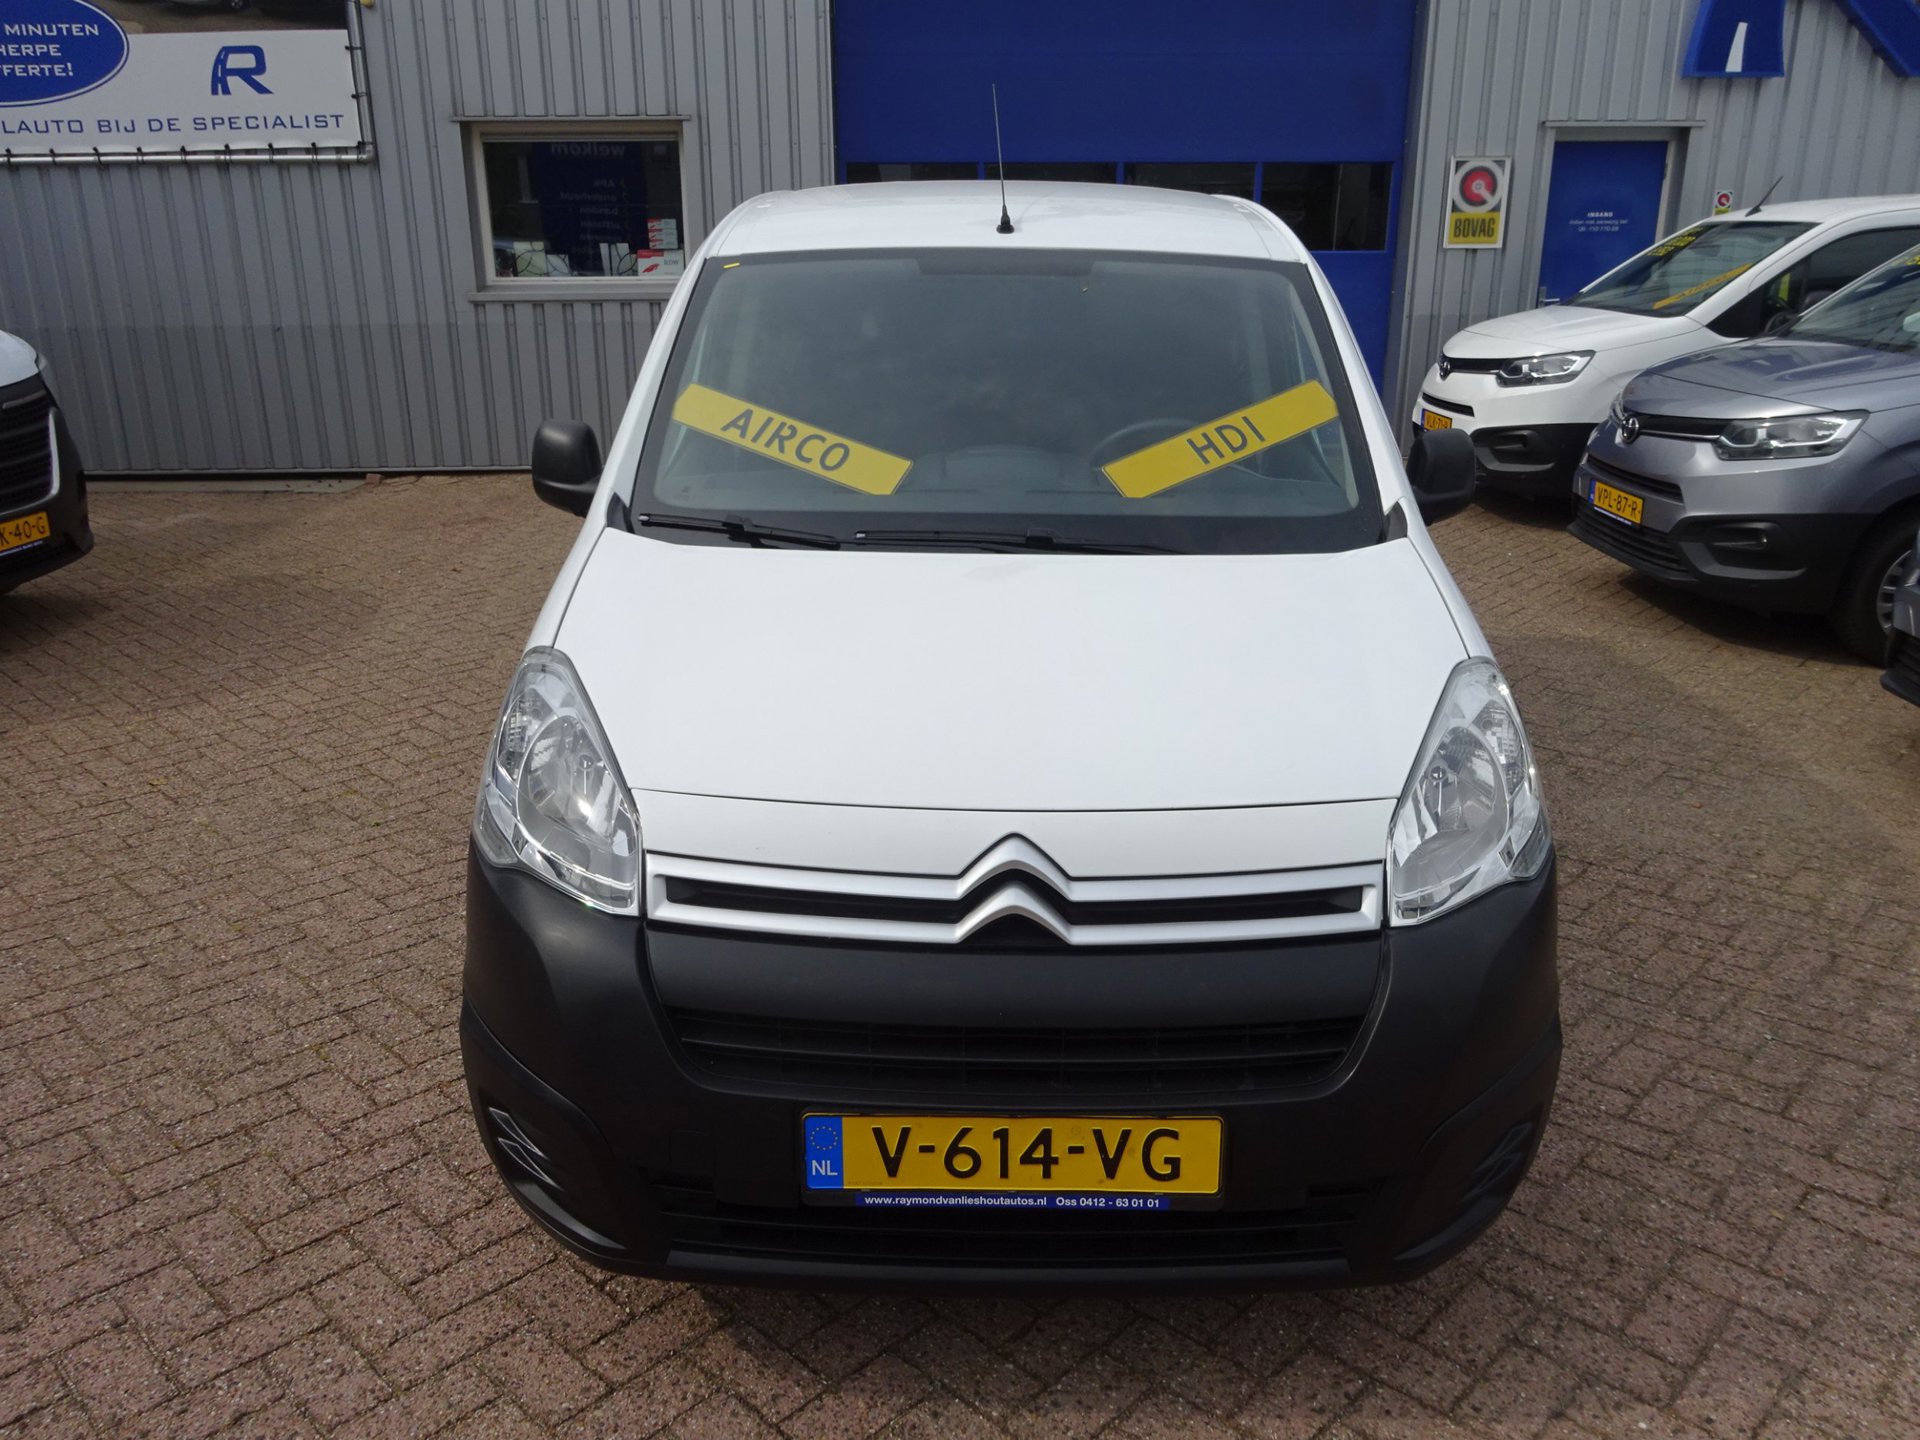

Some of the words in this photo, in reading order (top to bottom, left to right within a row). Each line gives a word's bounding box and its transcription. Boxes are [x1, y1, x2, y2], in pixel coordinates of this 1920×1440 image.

[4, 23, 99, 36] MINUTEN
[0, 62, 73, 77] FERTE!
[1, 119, 84, 134] LAUTO
[97, 119, 136, 133] BIJ
[148, 118, 181, 132] DE
[193, 114, 344, 131] SPECIALIST
[1454, 217, 1496, 238] BOVAG
[720, 408, 850, 471] AIRCO
[1186, 416, 1266, 465] HDI
[1597, 487, 1637, 519] VPL-87-R
[871, 1126, 1182, 1182] V-614-VG
[811, 1159, 838, 1176] NL
[864, 1196, 1047, 1206] www.raymondvanlieshoutautos.nl
[1055, 1197, 1077, 1206] Oss
[1079, 1197, 1106, 1207] 0412
[1115, 1198, 1129, 1207] 63
[1131, 1198, 1143, 1208] 01
[1147, 1199, 1159, 1208] 01
